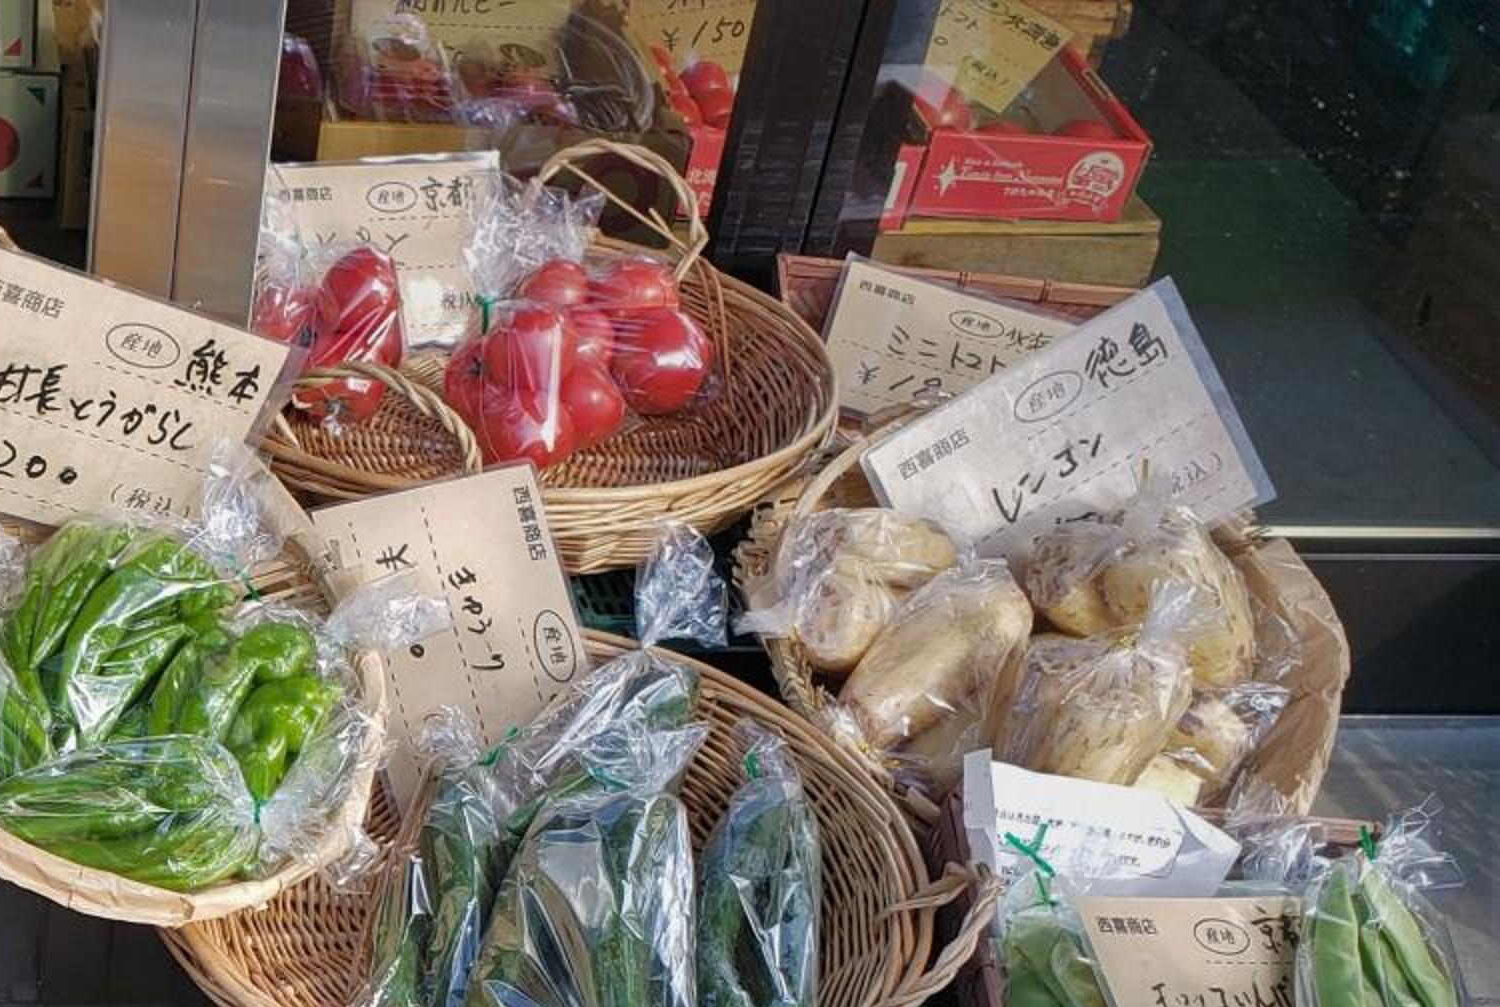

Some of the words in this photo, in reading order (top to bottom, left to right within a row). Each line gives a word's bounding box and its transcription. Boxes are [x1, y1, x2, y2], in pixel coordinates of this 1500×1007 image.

[690, 16, 747, 47] 150
[376, 190, 406, 206] 産地
[858, 278, 916, 306] 西喜商店
[960, 314, 993, 334] 産地
[119, 331, 165, 358] 産地
[173, 338, 262, 403] 熊本
[898, 426, 972, 481] 西喜商店
[1028, 380, 1068, 414] 産地
[1085, 321, 1169, 389] 徳島
[512, 485, 547, 562] 西喜商店
[542, 625, 568, 665] 産地
[447, 566, 506, 671] きゅうり
[1096, 915, 1158, 936] 西喜商店
[1205, 926, 1236, 946] 産地
